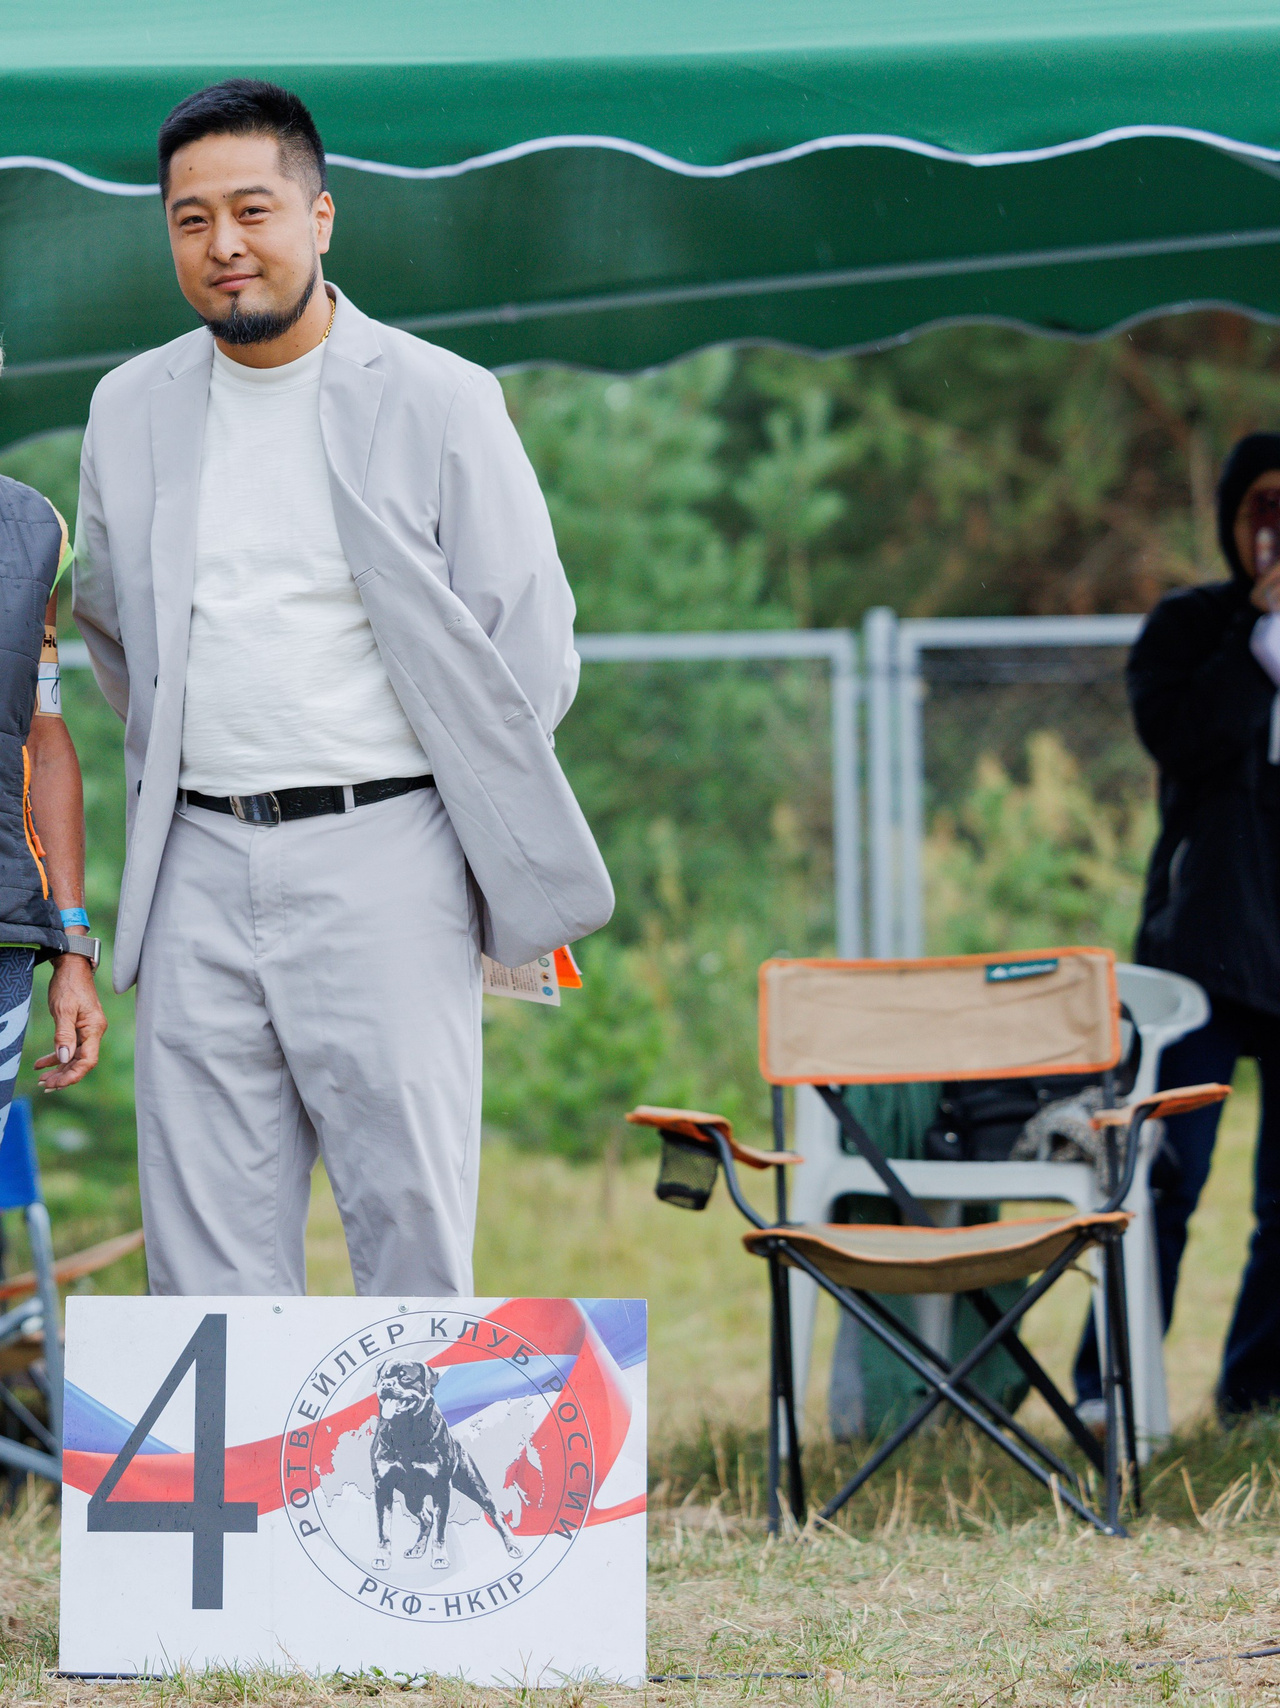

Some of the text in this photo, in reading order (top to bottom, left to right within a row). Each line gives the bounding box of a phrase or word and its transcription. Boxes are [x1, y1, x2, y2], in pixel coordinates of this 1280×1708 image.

[87, 1313, 258, 1609] 4
[286, 1317, 590, 1541] РОТВЕЙЛЕР КЛУБ РОССИИ
[357, 1571, 524, 1618] РКФ-НКПР
